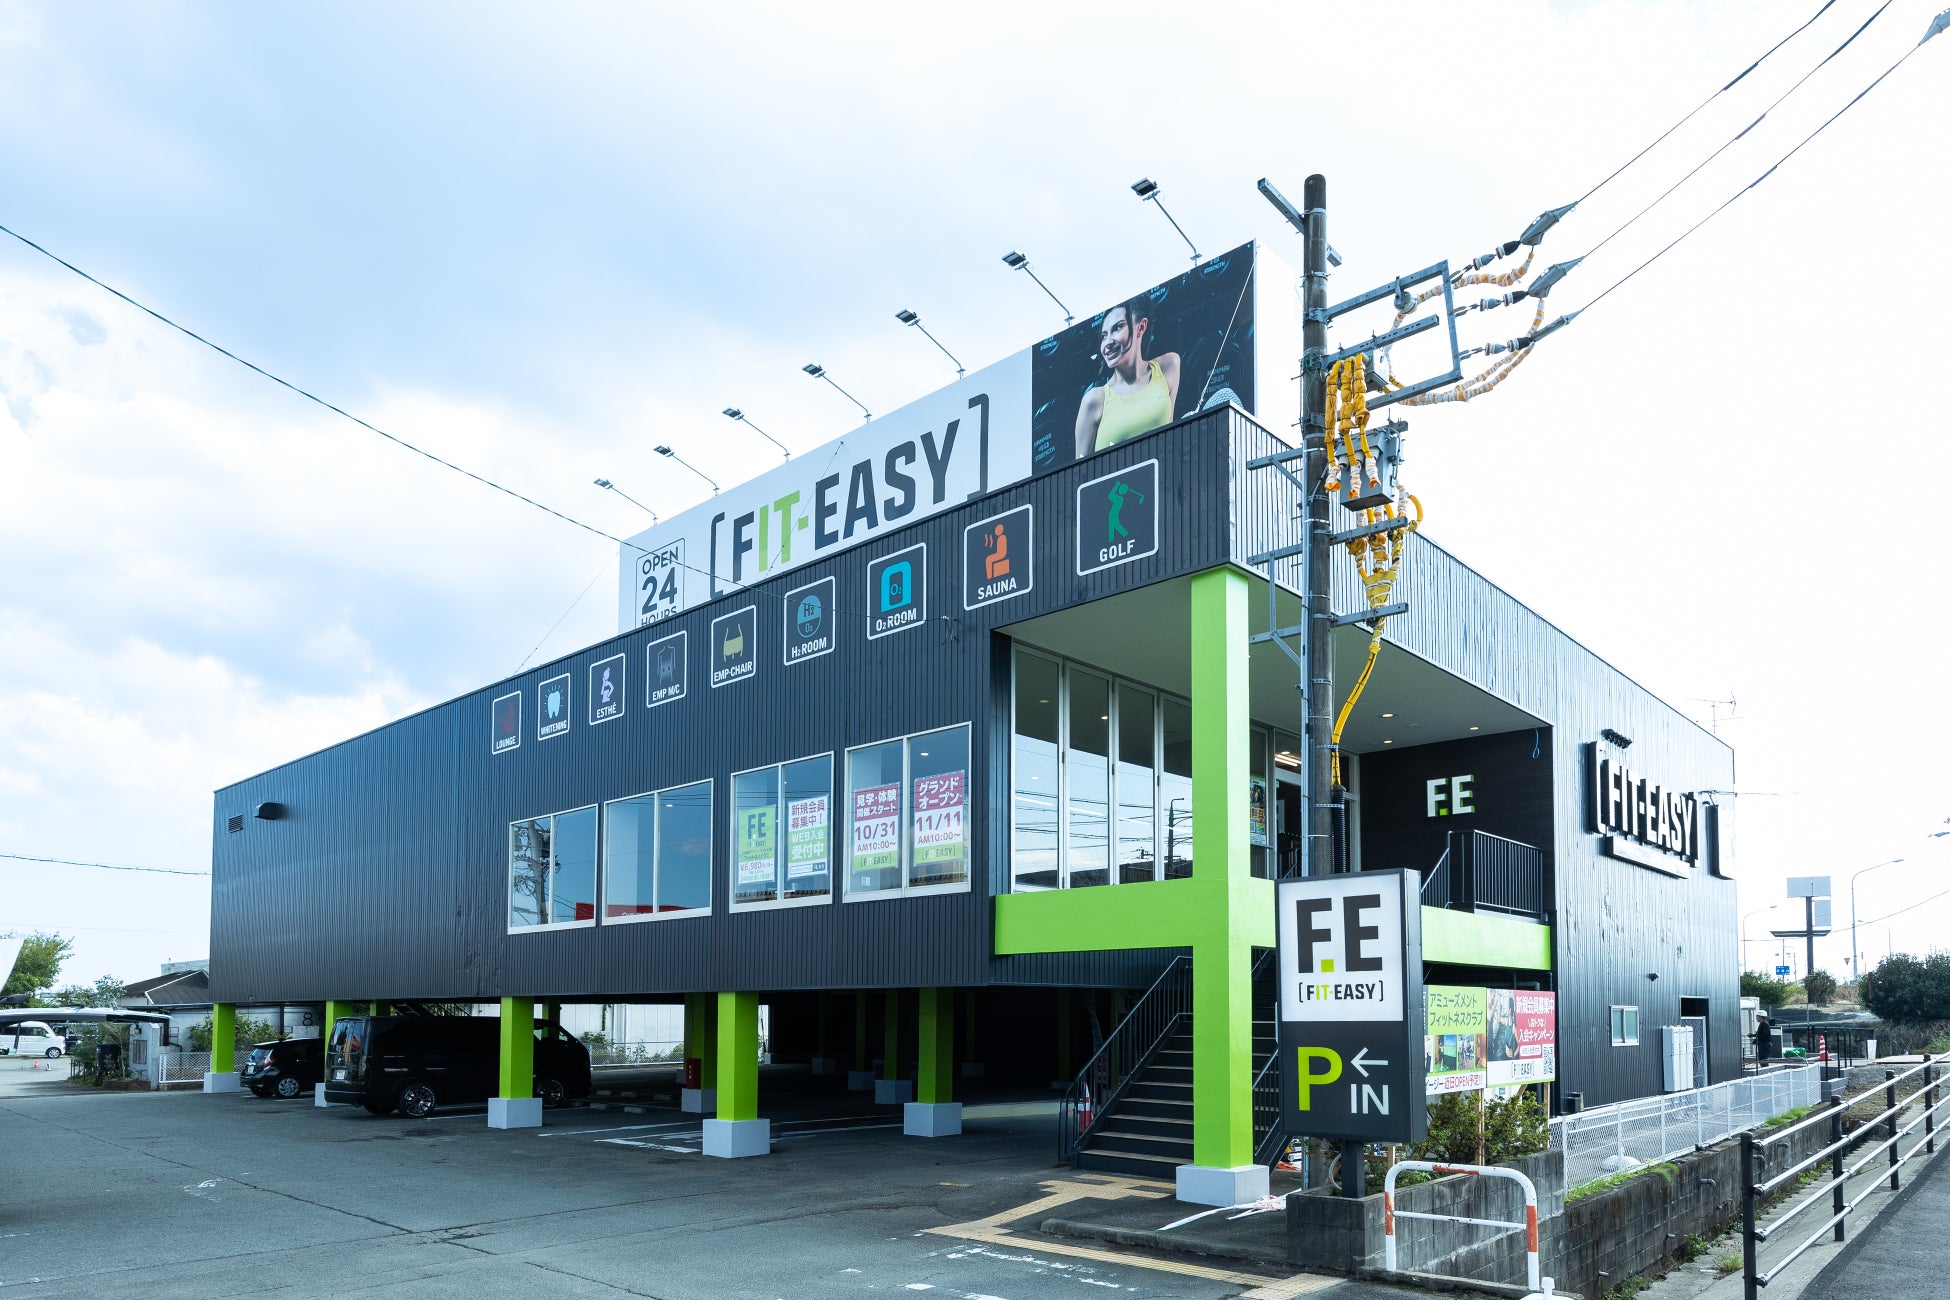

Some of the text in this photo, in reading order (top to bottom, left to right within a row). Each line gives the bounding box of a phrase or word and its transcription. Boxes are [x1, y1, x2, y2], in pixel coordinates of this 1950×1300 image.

[642, 546, 678, 575] OPEN
[1099, 539, 1135, 562] GOLF
[642, 567, 678, 615] 24
[978, 577, 1017, 600] SAUNA
[652, 688, 667, 701] EMP
[496, 736, 516, 749] LOUNGE
[919, 776, 959, 796] グランド
[791, 799, 825, 816] 新規会員
[919, 792, 960, 809] オープン
[855, 820, 896, 841] 10/31
[916, 810, 961, 832] 11/11
[792, 829, 825, 843] WEB入会
[791, 842, 824, 860] 受付中
[1429, 992, 1477, 1008] アミューズメント
[1516, 995, 1555, 1015] 新規会員募集中
[1429, 1010, 1483, 1027] フィットネスクラブ
[1518, 1028, 1555, 1043] 入会キャンペーン
[1297, 1046, 1343, 1112] P
[1350, 1083, 1390, 1115] IN
